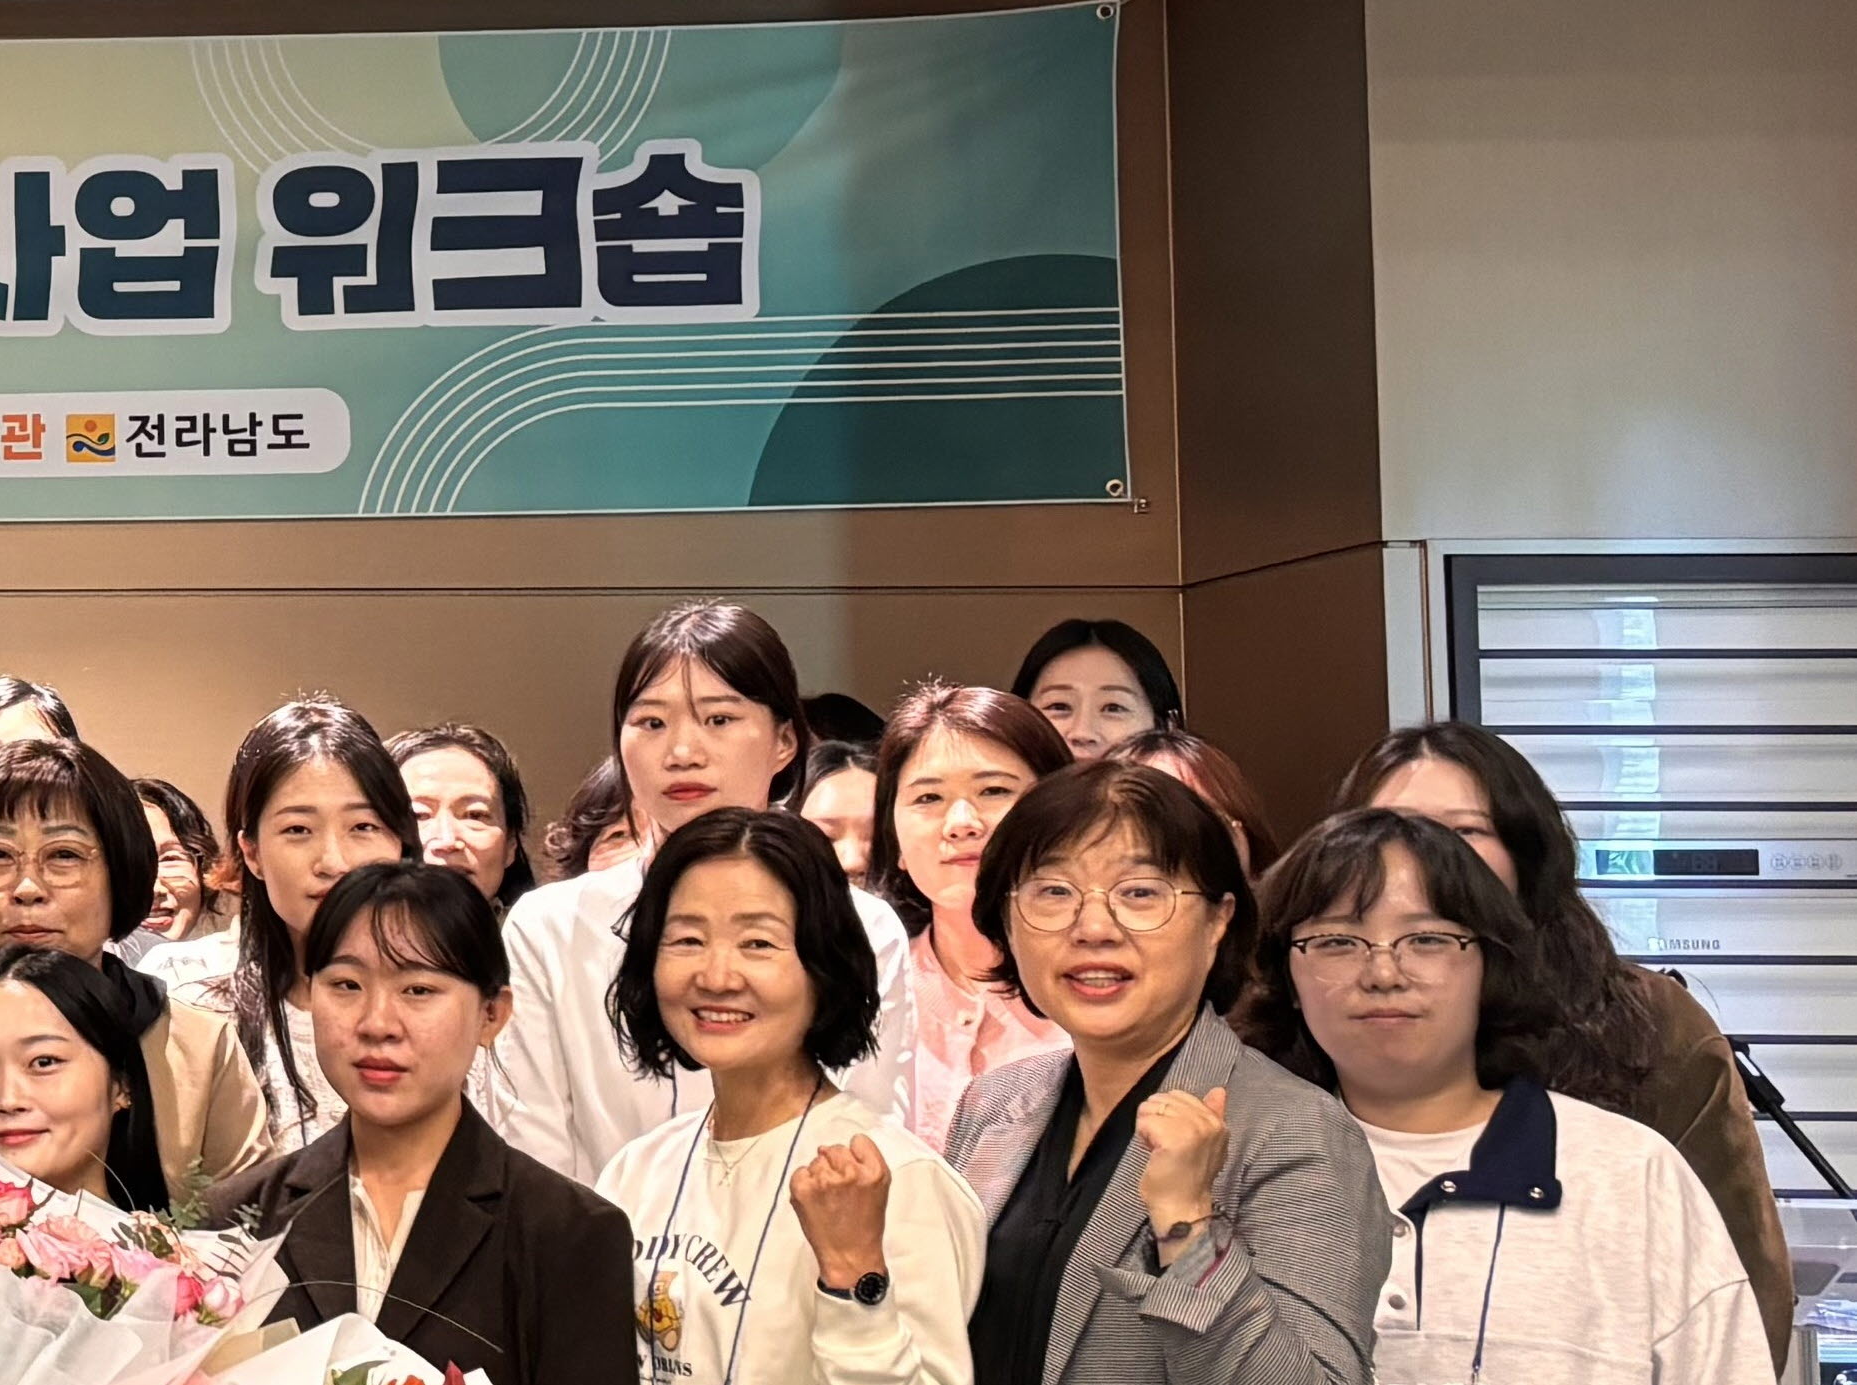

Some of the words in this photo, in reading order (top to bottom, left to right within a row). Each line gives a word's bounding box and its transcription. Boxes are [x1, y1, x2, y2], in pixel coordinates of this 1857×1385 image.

[270, 152, 745, 314] 워크숍
[125, 412, 310, 458] 전라남도
[1648, 937, 1720, 951] AMSUNG
